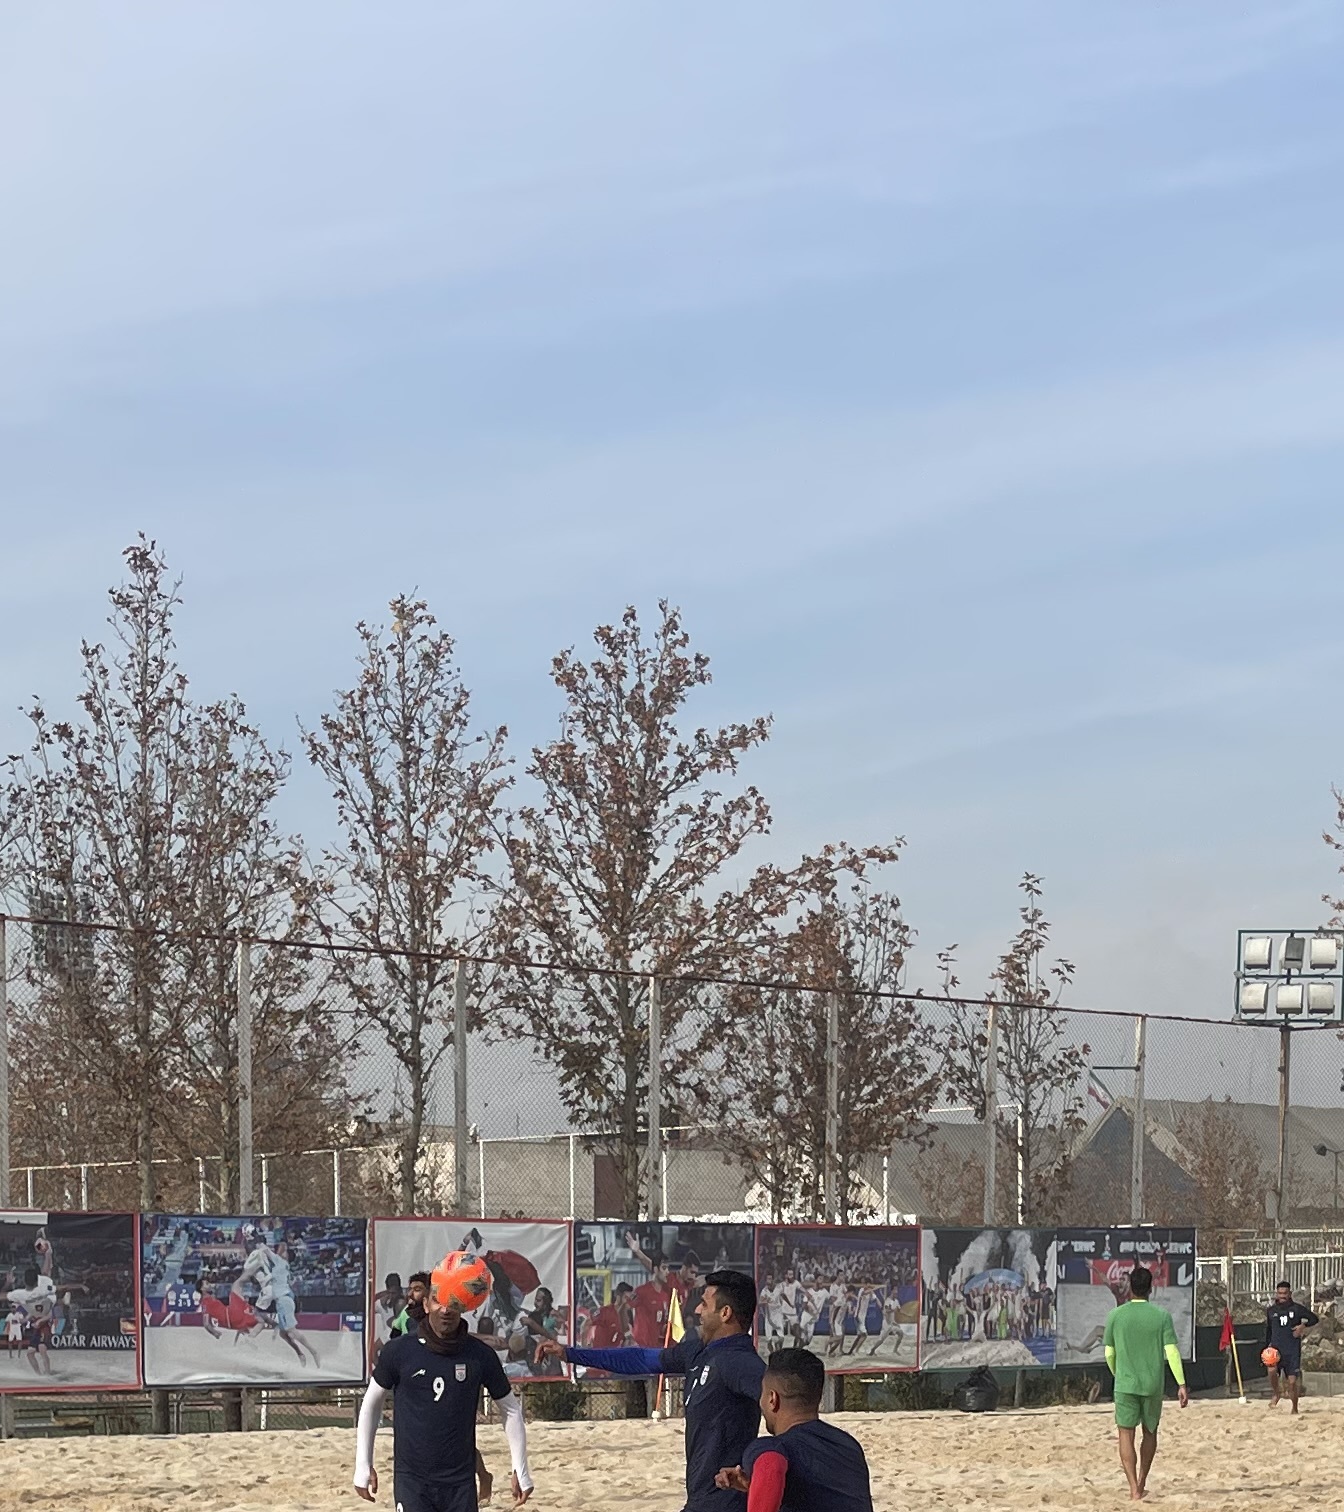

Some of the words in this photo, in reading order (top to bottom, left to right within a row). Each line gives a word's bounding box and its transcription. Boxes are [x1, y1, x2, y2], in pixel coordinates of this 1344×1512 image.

[51, 1335, 86, 1348] QATAR
[89, 1335, 137, 1348] AIRWAYS
[432, 1376, 445, 1402] 9
